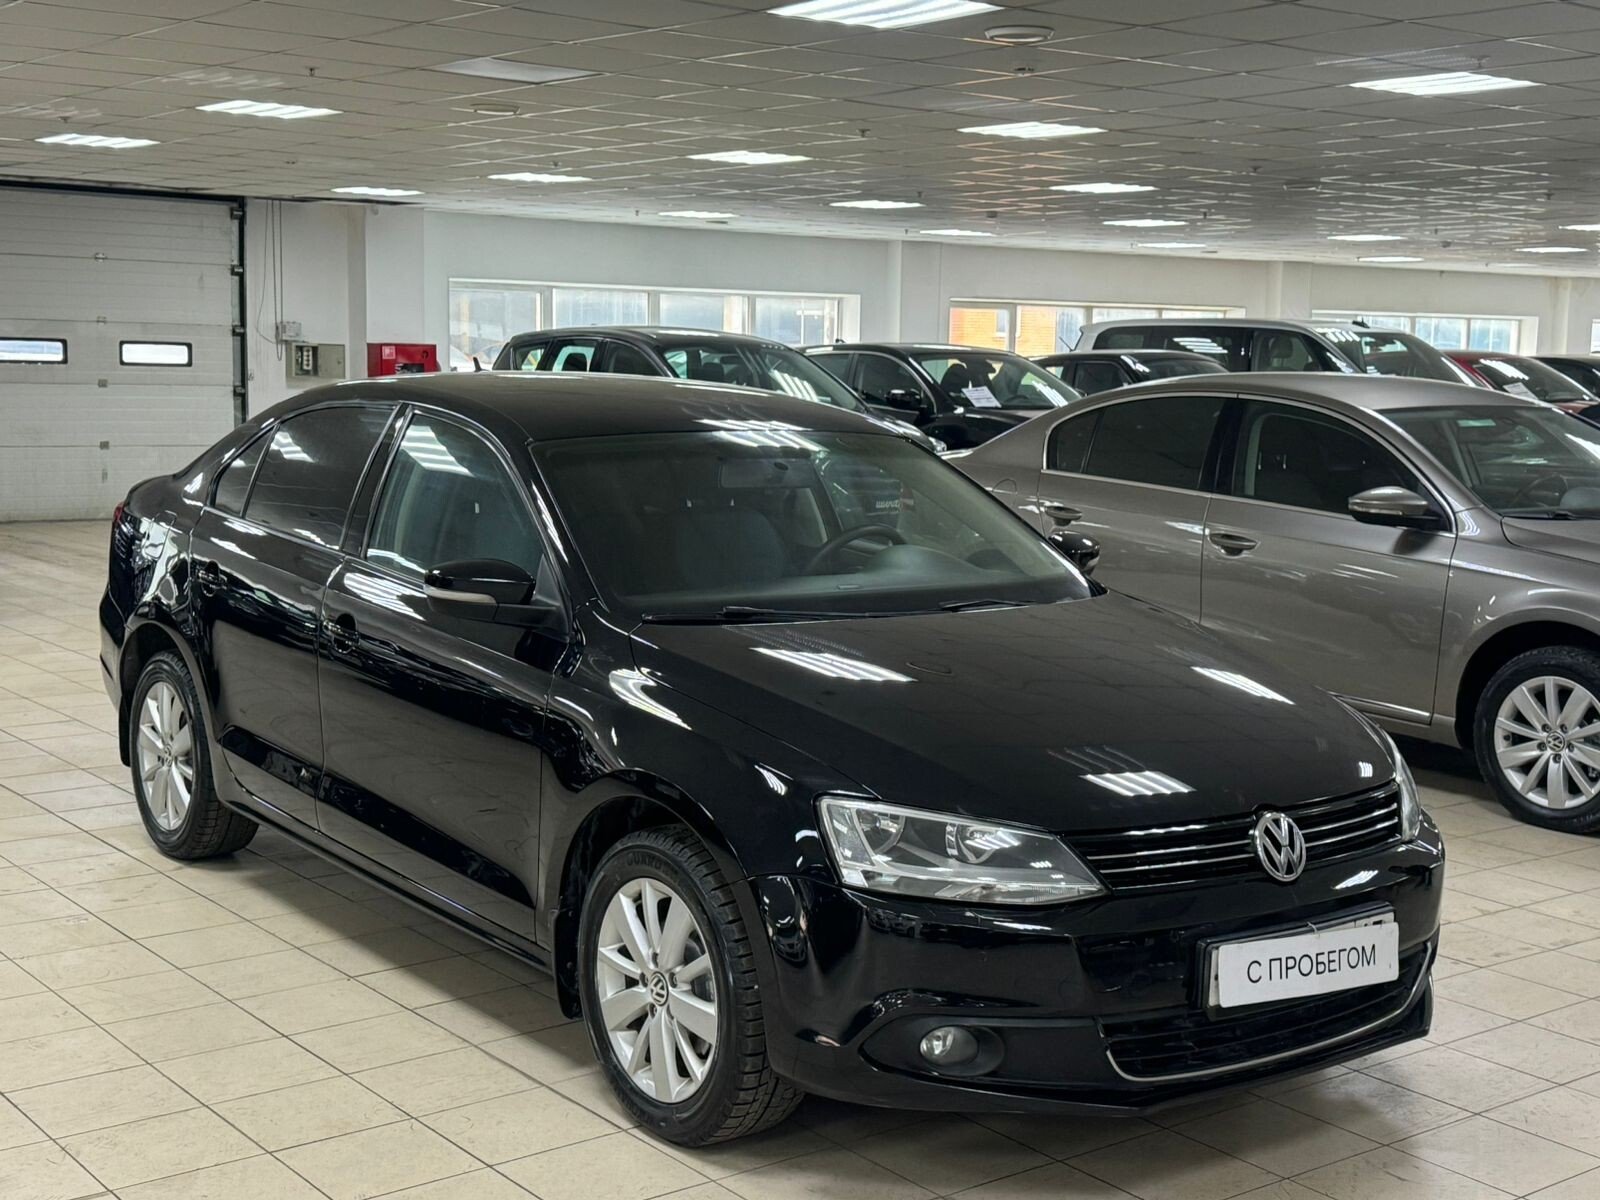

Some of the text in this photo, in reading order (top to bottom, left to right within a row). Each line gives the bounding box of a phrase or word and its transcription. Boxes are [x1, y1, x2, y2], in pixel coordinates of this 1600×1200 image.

[1255, 812, 1305, 881] VW
[1247, 943, 1376, 983] С ПРОБЕГОМ
